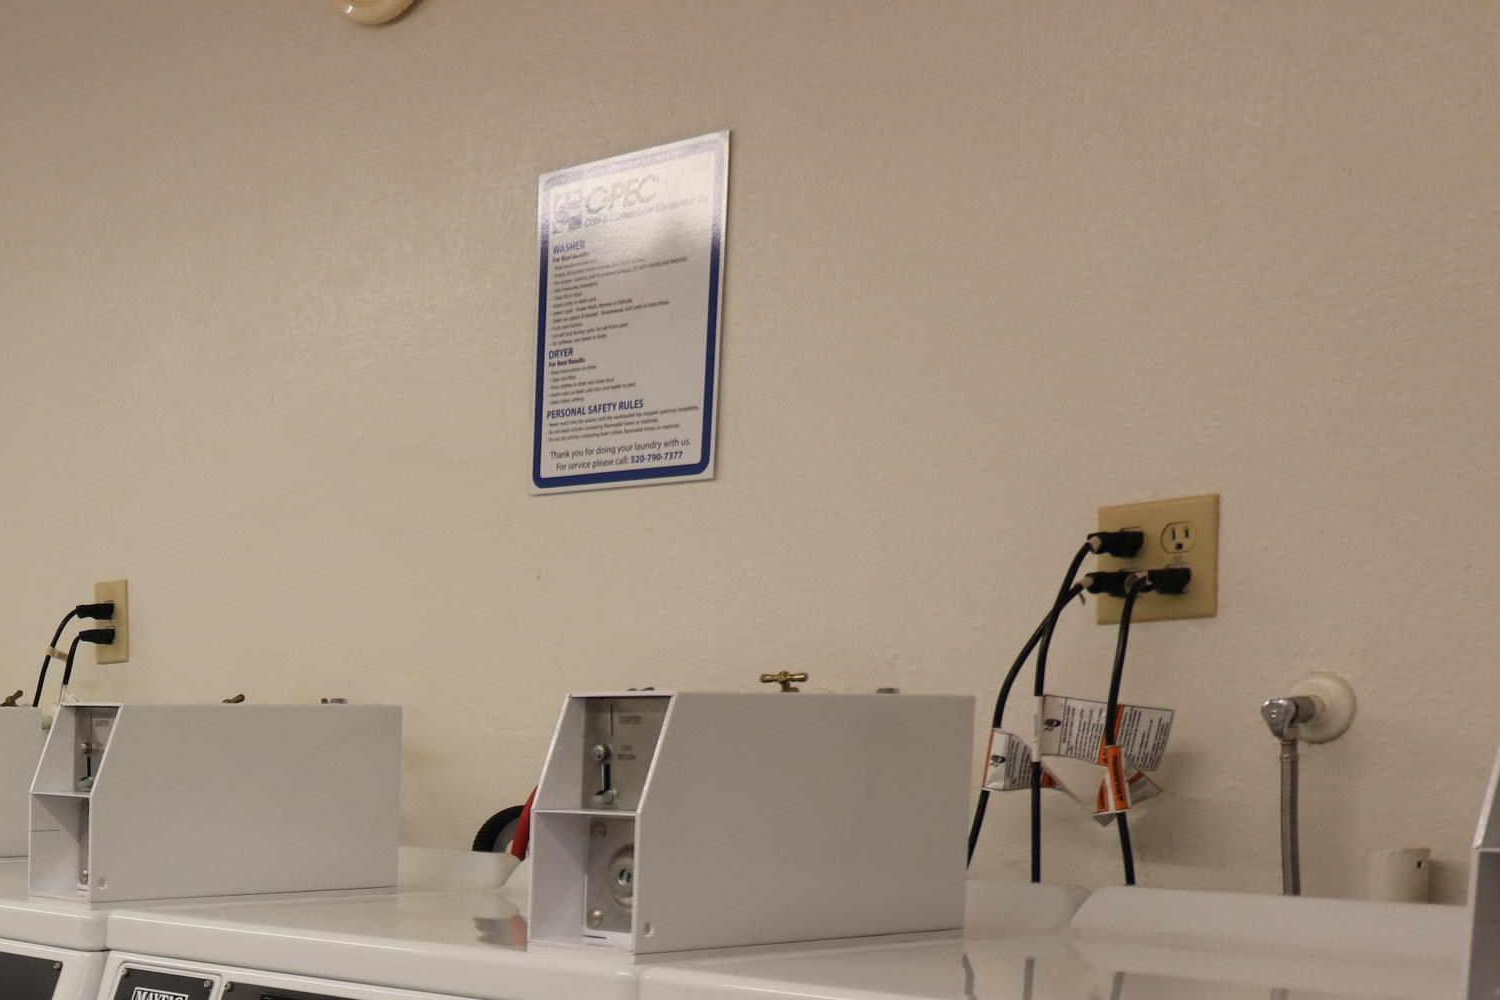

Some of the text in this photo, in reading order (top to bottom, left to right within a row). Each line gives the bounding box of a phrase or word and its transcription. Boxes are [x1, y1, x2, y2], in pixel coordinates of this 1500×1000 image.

[553, 240, 585, 254] WASHER
[549, 348, 573, 359] DRYER
[568, 357, 585, 365] Results
[547, 399, 644, 420] PERSONAL SAFETY RULES
[550, 450, 569, 460] Thank
[571, 449, 584, 458] you
[585, 448, 594, 456] for
[596, 445, 615, 455] doing
[618, 443, 632, 453] your
[634, 440, 661, 451] laundry
[662, 438, 679, 448] with
[556, 463, 566, 471] For
[568, 460, 590, 470] service
[592, 458, 614, 467] please
[631, 451, 683, 463] 520-790-7377
